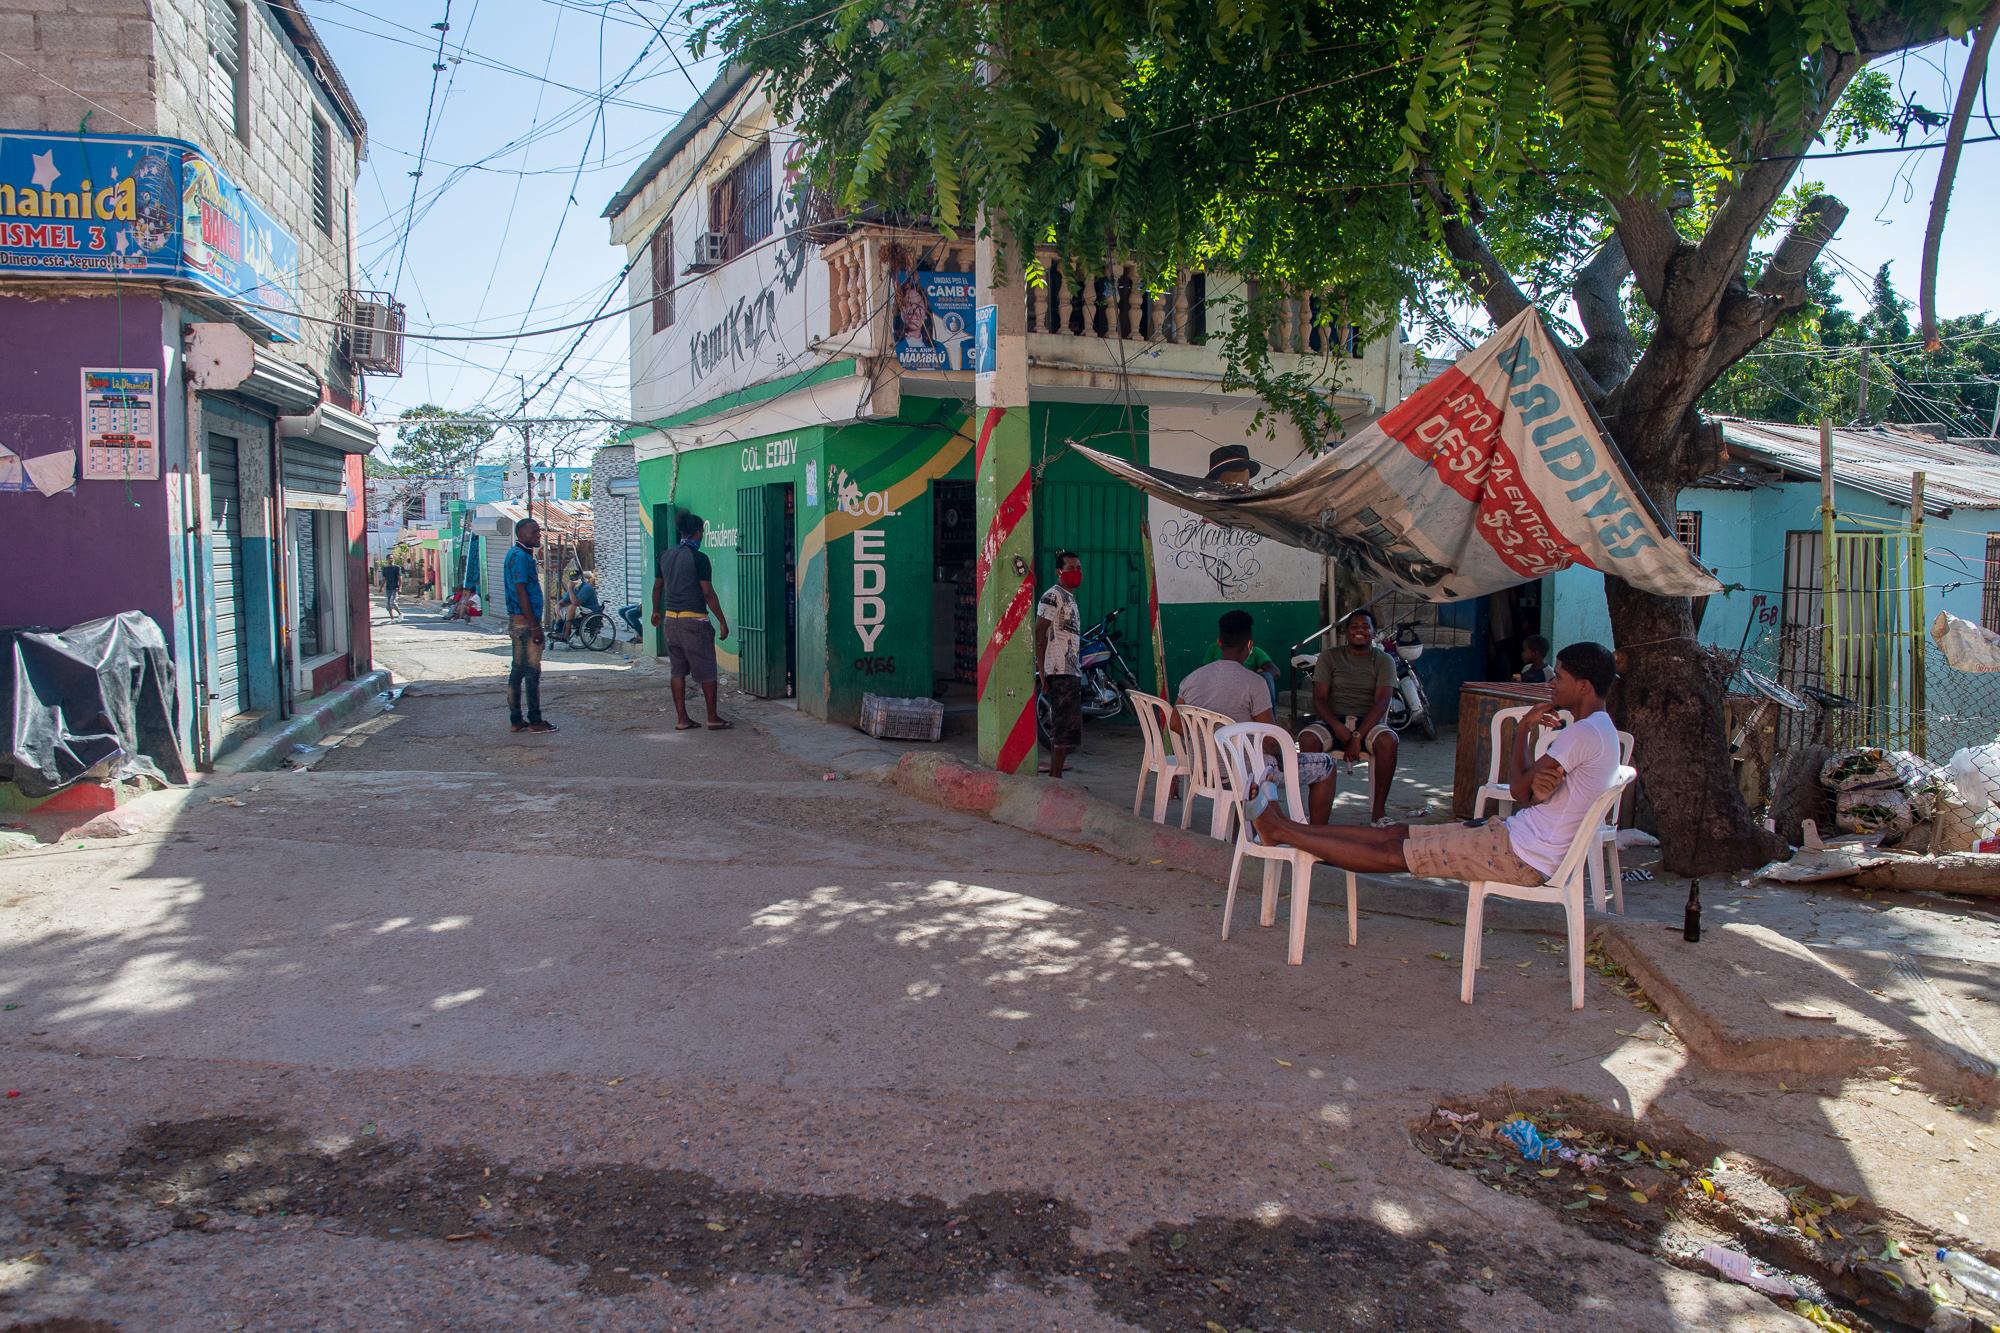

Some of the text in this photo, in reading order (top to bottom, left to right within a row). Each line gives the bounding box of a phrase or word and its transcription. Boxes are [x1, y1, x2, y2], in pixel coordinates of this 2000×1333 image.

[88, 226, 106, 250] 3
[201, 199, 240, 265] BANCA
[0, 252, 39, 266] Dinero
[42, 257, 65, 267] esta
[1444, 394, 1493, 433] ISTO
[741, 436, 799, 473] COL. EDDY
[702, 519, 738, 548] Presidente
[853, 529, 887, 653] EDDY
